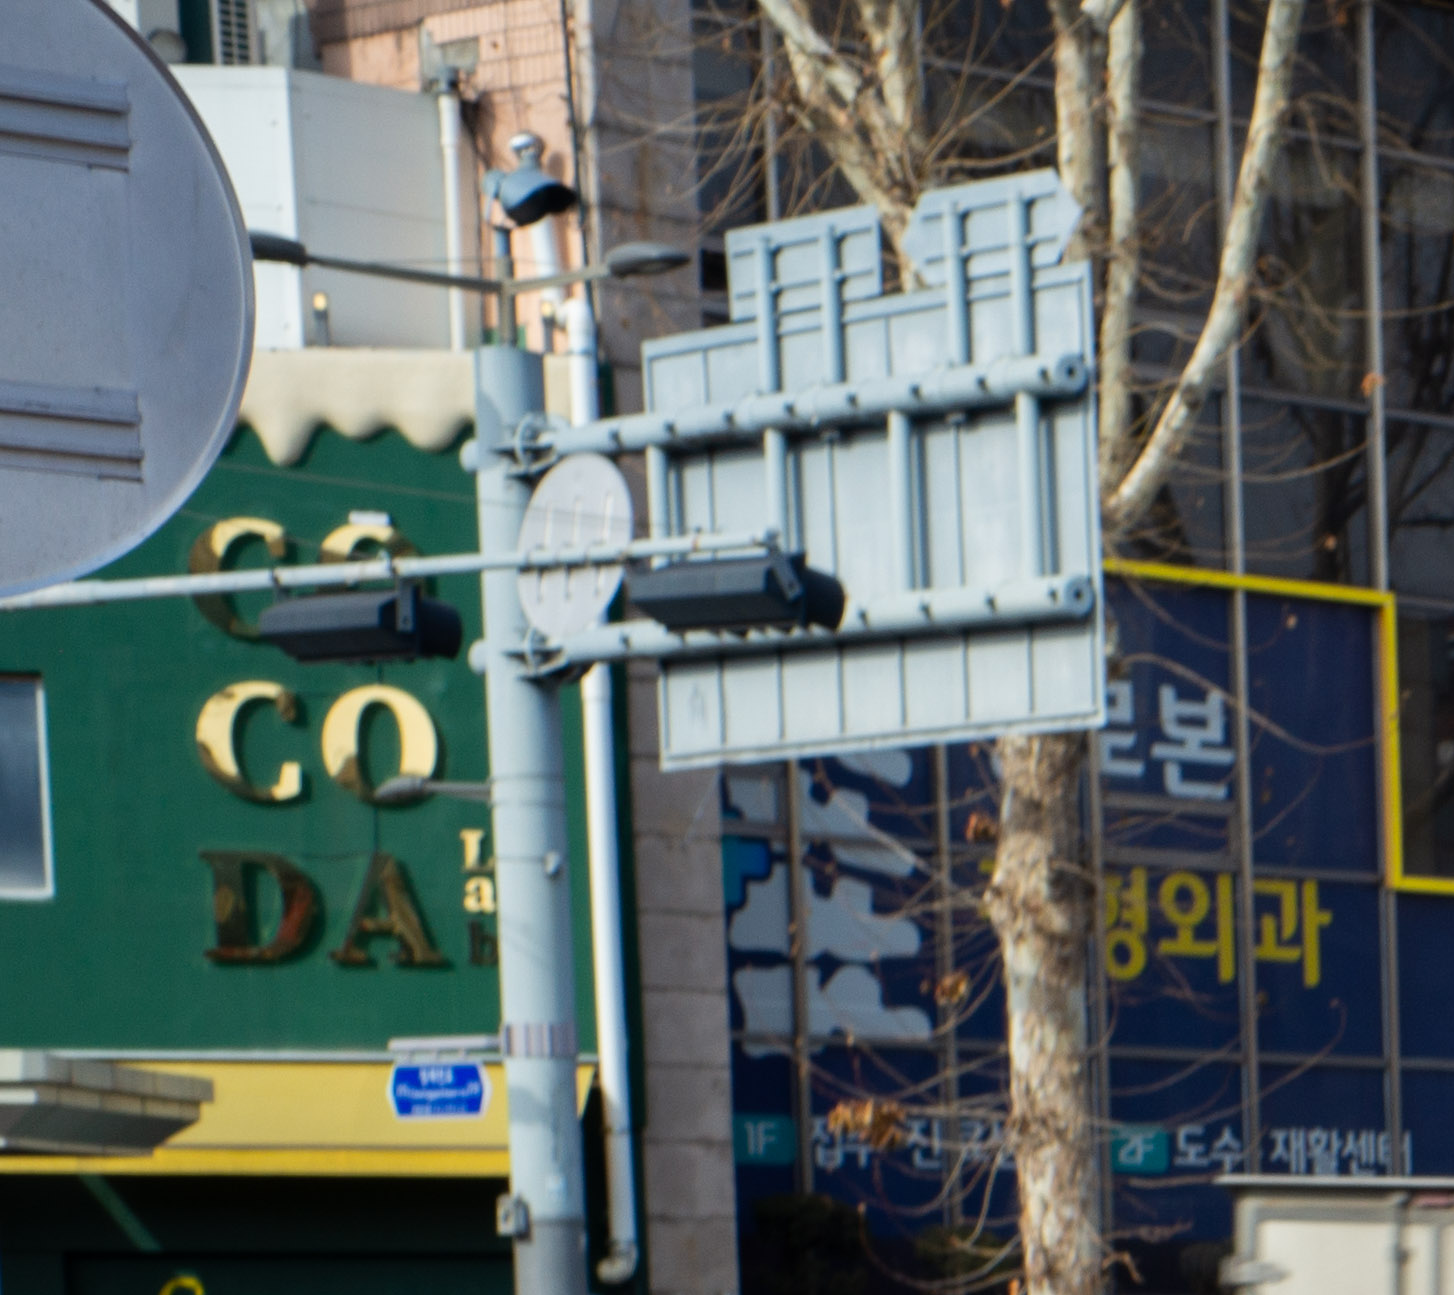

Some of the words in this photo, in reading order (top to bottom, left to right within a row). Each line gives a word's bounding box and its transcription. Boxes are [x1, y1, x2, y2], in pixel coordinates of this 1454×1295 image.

[195, 679, 440, 804] CO
[198, 849, 447, 967] DA
[1103, 866, 1335, 990] 형외과
[744, 1120, 778, 1156] 1F
[1173, 1122, 1247, 1176] 도수
